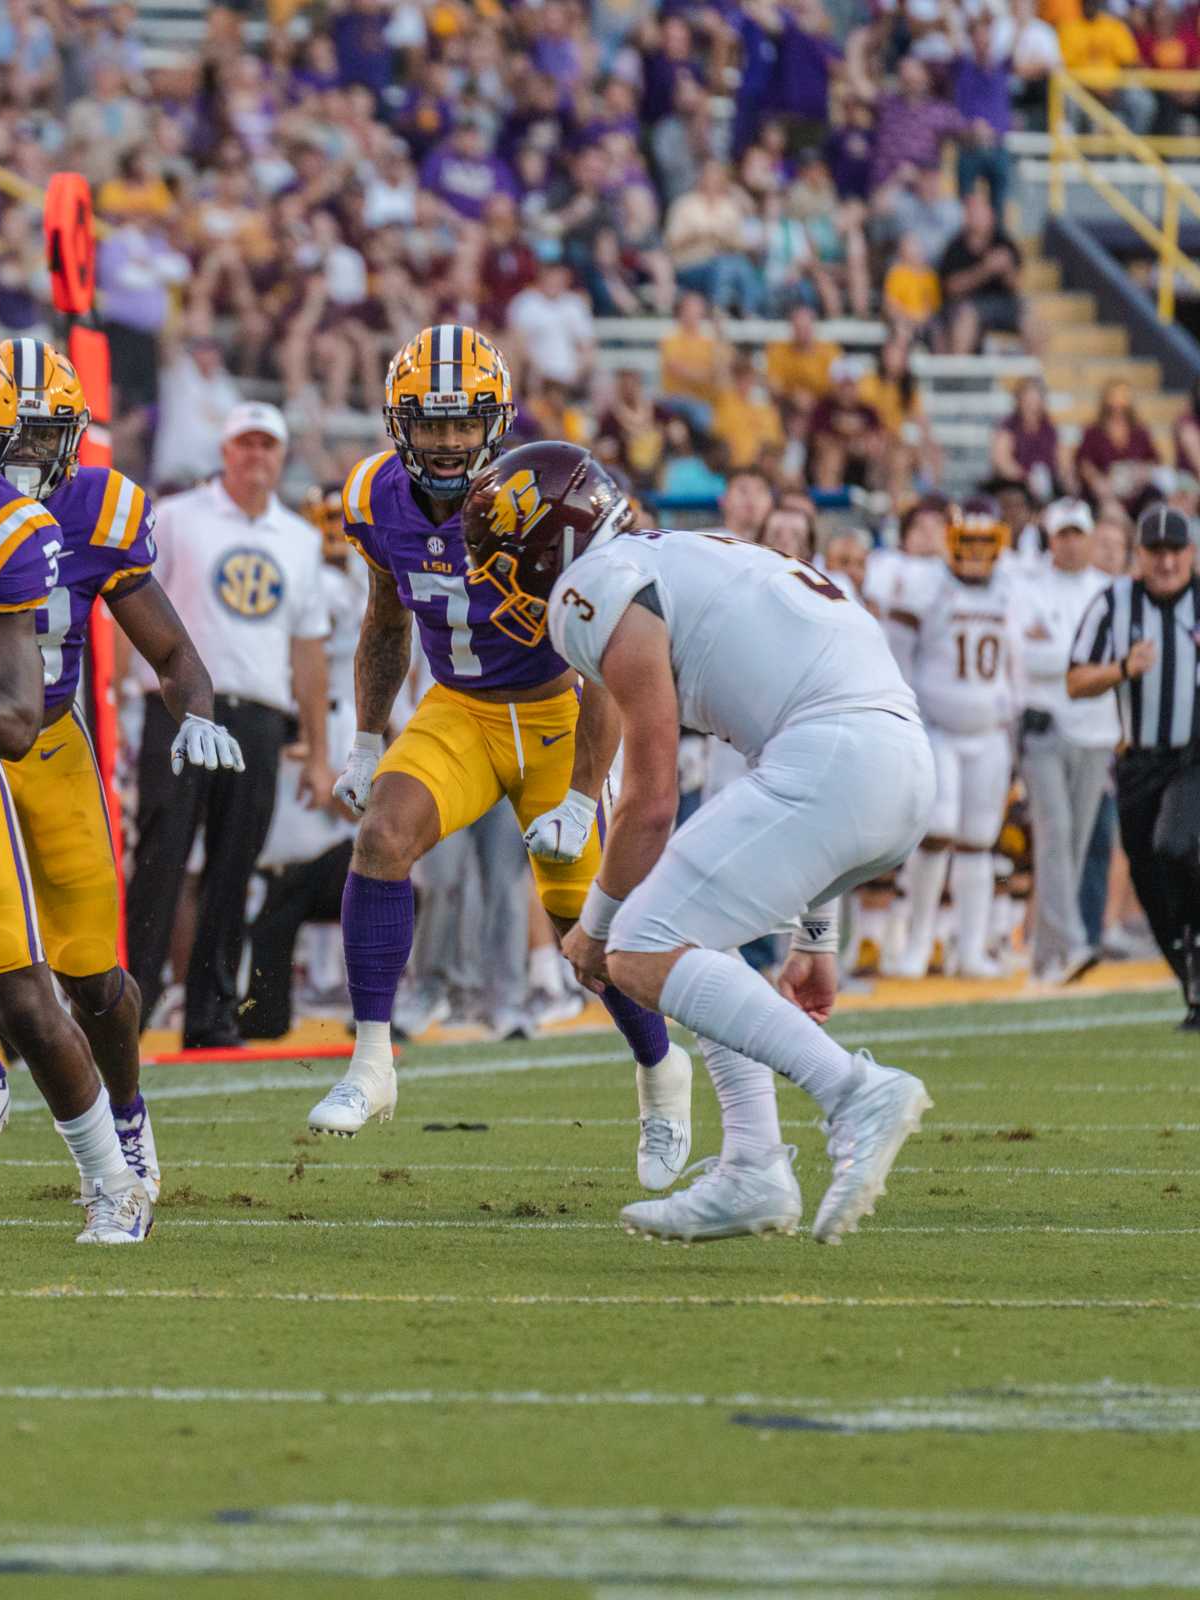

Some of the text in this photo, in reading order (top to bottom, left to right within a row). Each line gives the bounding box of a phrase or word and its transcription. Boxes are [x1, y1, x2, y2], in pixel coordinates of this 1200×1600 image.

[434, 394, 458, 404] LSU
[41, 539, 62, 588] 3
[221, 553, 279, 613] SEC
[423, 560, 452, 574] LSU
[407, 572, 482, 676] 7
[561, 587, 595, 622] 3
[957, 630, 999, 682] 10
